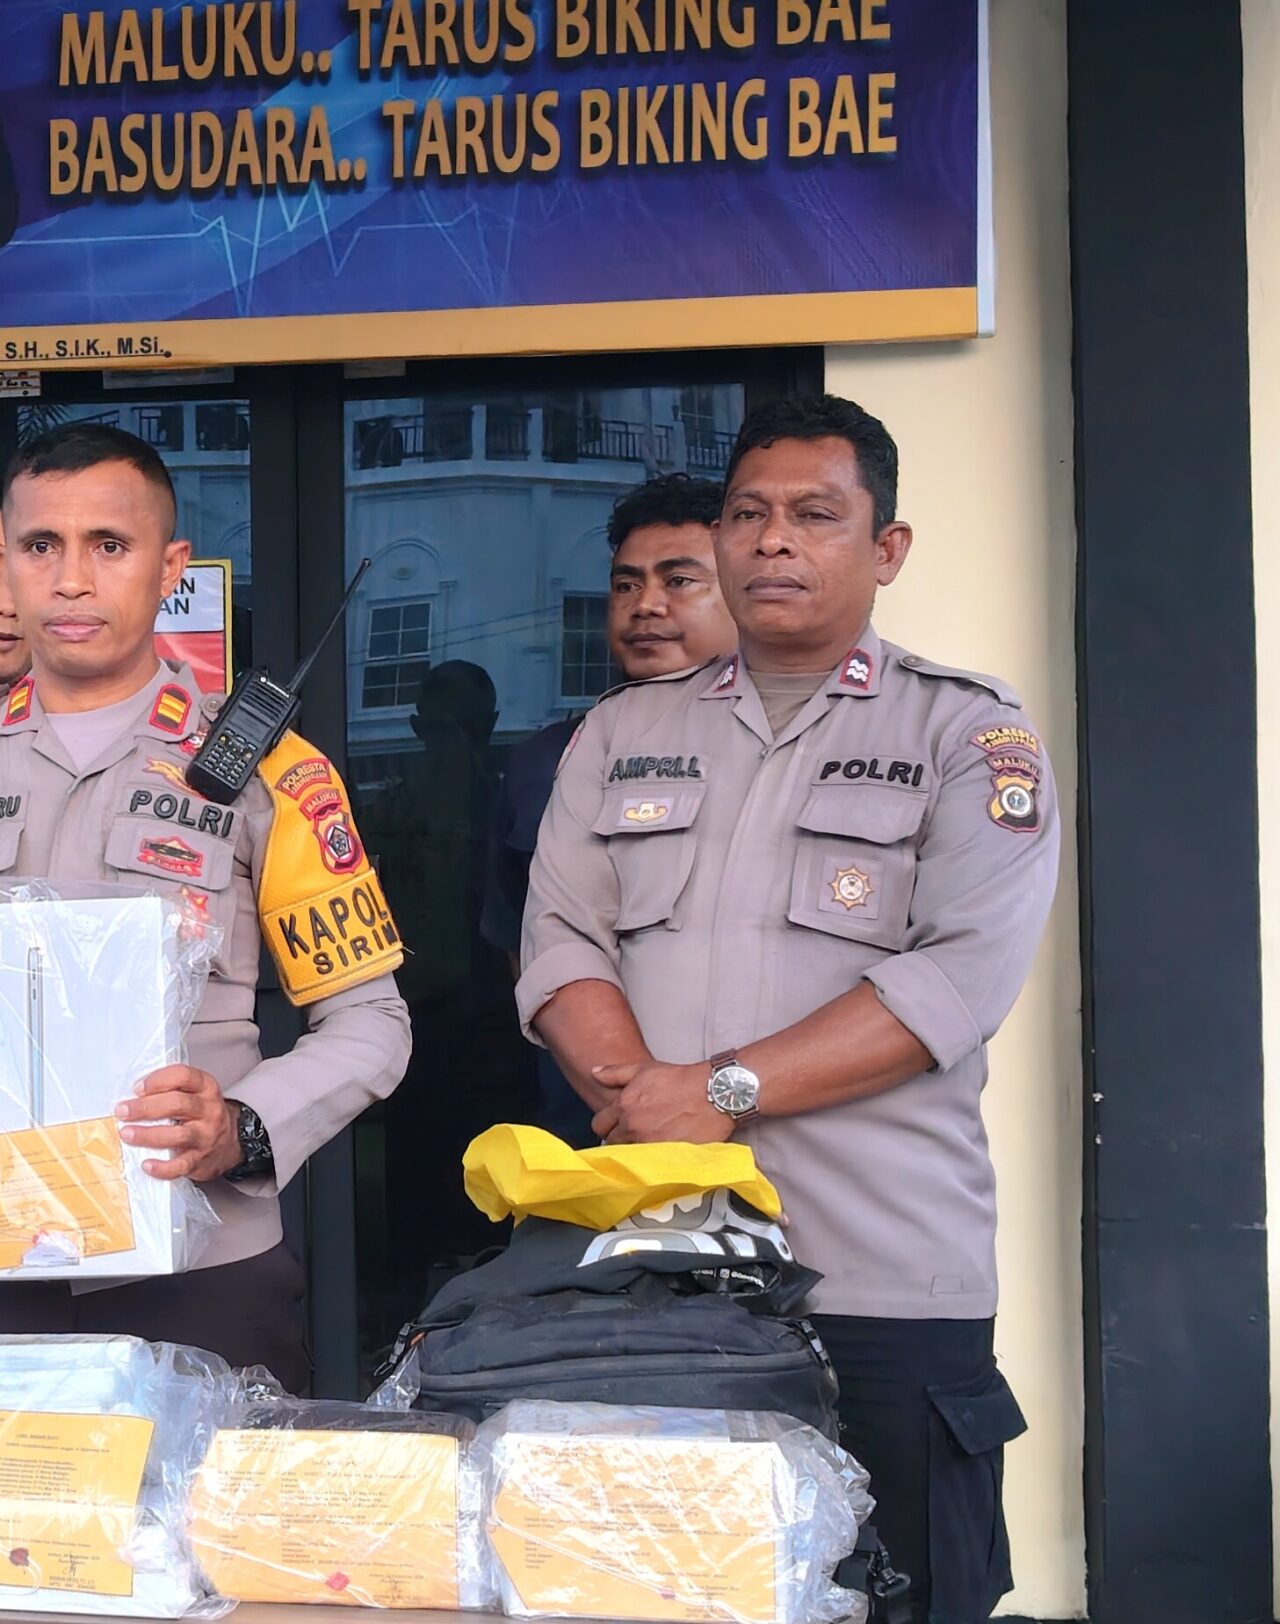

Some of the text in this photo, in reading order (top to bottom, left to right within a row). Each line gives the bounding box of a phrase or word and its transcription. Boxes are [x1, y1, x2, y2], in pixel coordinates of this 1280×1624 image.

[348, 0, 536, 70] TARUS
[556, 0, 756, 59] BIKING
[49, 72, 898, 196] BASUDARA.. TARUS BIKING BAE
[5, 341, 50, 361] S.H.,
[56, 338, 111, 358] S.I.K.,
[281, 762, 327, 791] POLRESTA
[819, 757, 924, 788] POLRI
[129, 789, 235, 838] POLRI
